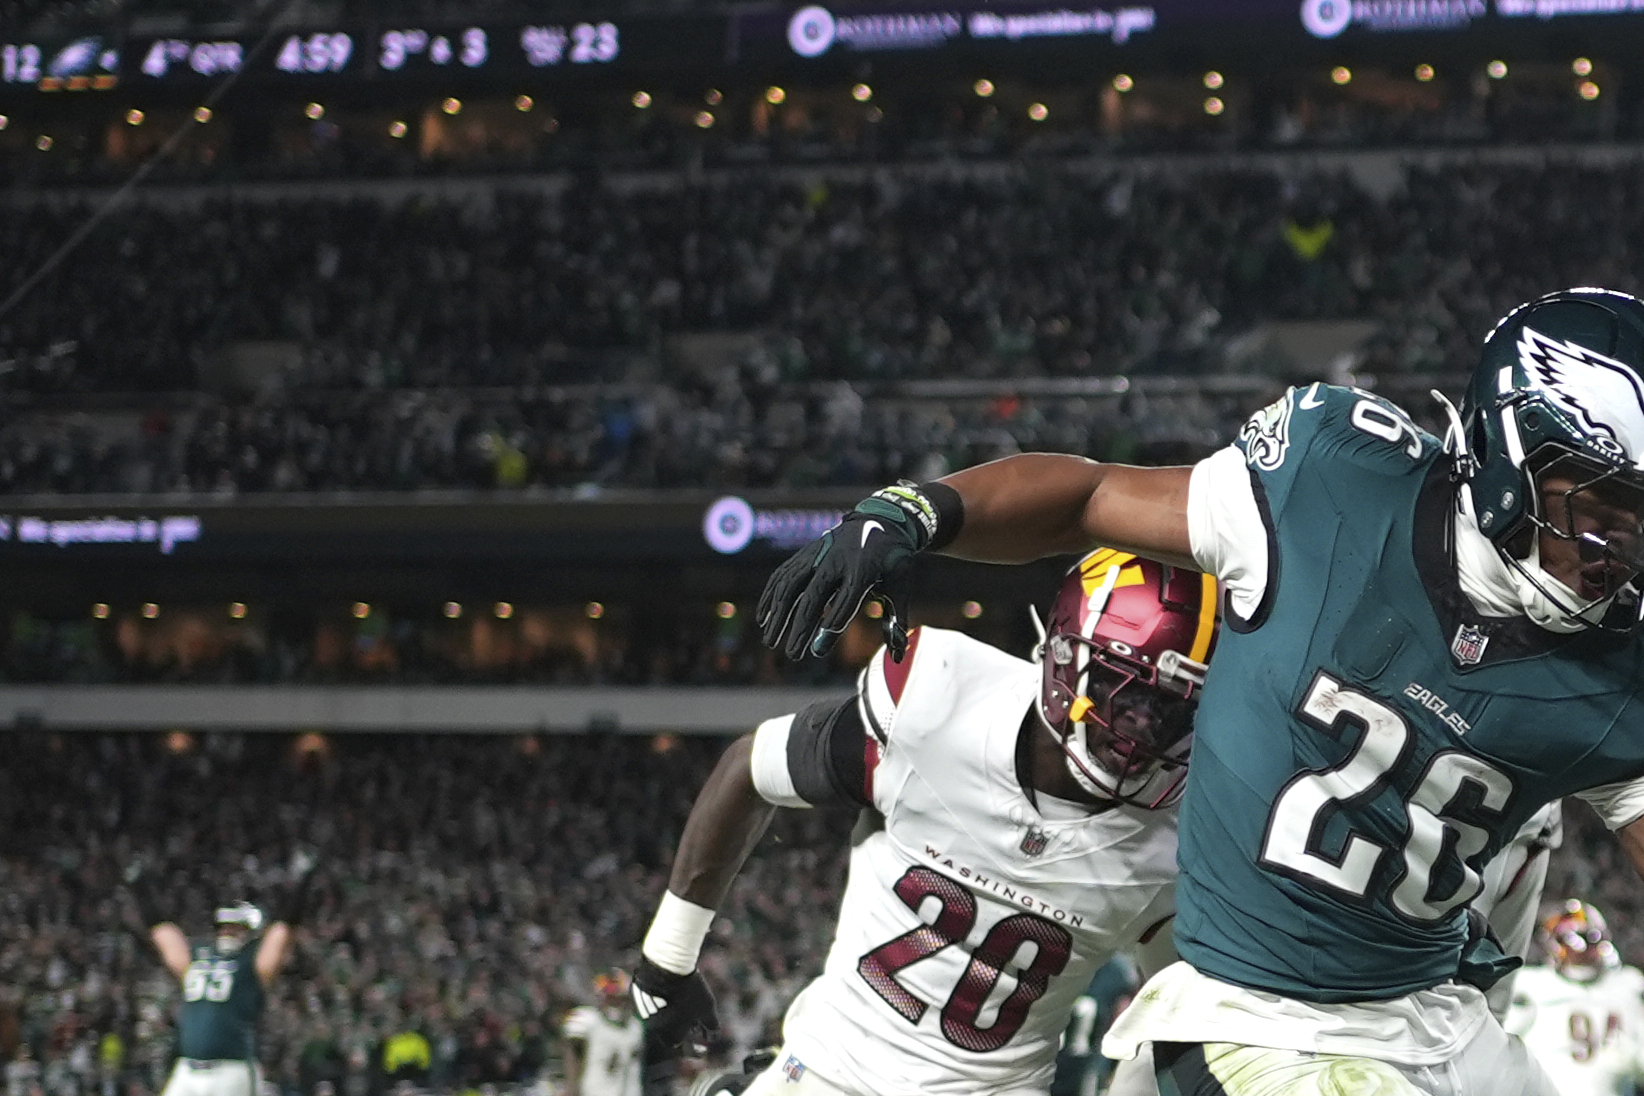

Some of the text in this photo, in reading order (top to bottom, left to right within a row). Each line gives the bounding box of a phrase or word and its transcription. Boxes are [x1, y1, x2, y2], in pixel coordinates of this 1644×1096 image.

[1457, 640, 1478, 659] NFL
[1403, 682, 1472, 736] EAGLES
[1257, 667, 1520, 922] 26
[924, 845, 1084, 928] WASHINGTON
[856, 864, 1073, 1053] 20
